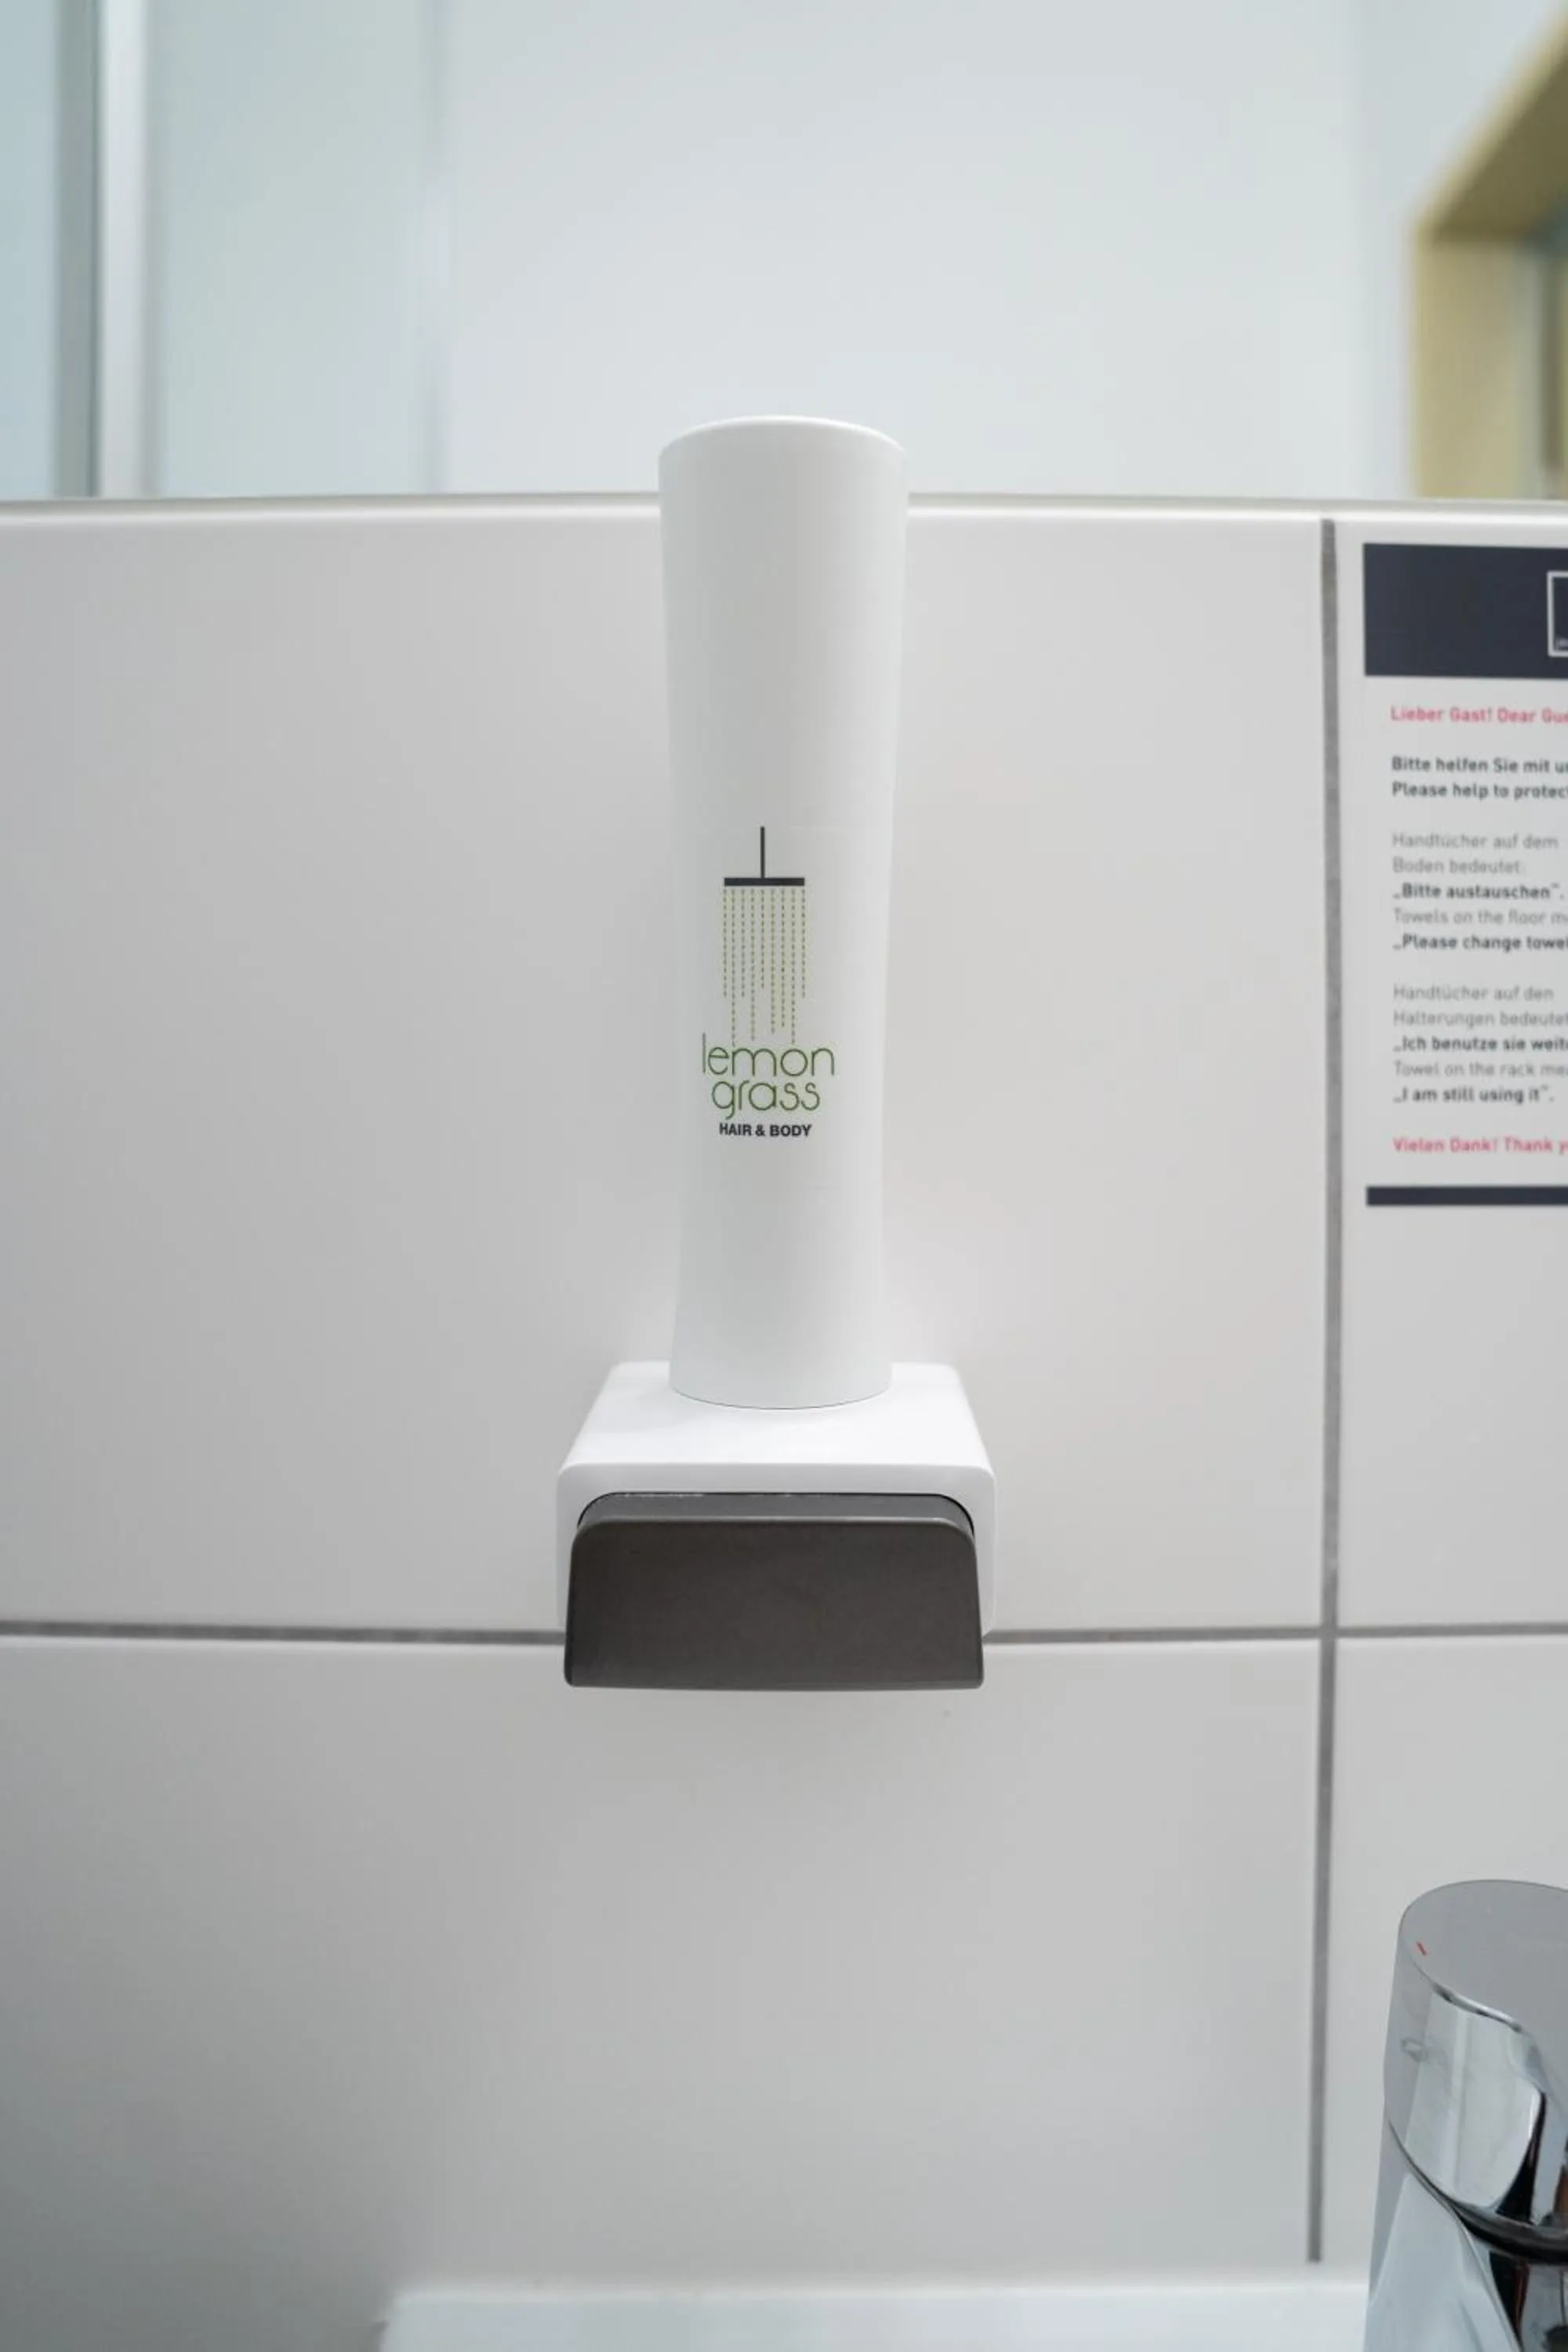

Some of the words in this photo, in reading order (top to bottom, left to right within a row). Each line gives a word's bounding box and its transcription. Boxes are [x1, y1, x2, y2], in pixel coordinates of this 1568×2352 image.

[1391, 706, 1444, 722] Lieber
[1497, 708, 1536, 724] Dear
[1392, 756, 1432, 772] Bitte
[1436, 757, 1488, 773] helfen
[1492, 757, 1519, 774] Sie
[1523, 758, 1551, 775] mit
[1392, 782, 1448, 798] Please
[1452, 782, 1489, 800] help
[1493, 784, 1509, 799] to
[1493, 833, 1519, 850] auf
[1523, 834, 1560, 850] dem
[1392, 858, 1445, 874] Boden
[1393, 908, 1450, 925] Towels
[1453, 912, 1474, 925] on
[1477, 909, 1504, 926] the
[1508, 909, 1547, 926] floor
[1462, 935, 1522, 953] change
[1494, 985, 1519, 1002] auf
[1523, 985, 1555, 1002] den
[1393, 1010, 1494, 1030] Halterungen
[1432, 1036, 1497, 1053] benutze
[1502, 1036, 1527, 1053] sie
[702, 1032, 834, 1076] lemon
[1393, 1061, 1440, 1078] Towel
[1444, 1065, 1465, 1078] on
[1468, 1062, 1496, 1079] the
[1499, 1062, 1534, 1079] rack
[712, 1080, 819, 1120] grass
[1412, 1091, 1438, 1104] am
[1443, 1087, 1475, 1104] still
[1479, 1087, 1524, 1105] using
[719, 1122, 752, 1136] HAIR
[755, 1124, 765, 1137] &
[770, 1123, 812, 1137] BODY
[1392, 1138, 1445, 1153] Vielen
[1504, 1138, 1553, 1155] Thank
